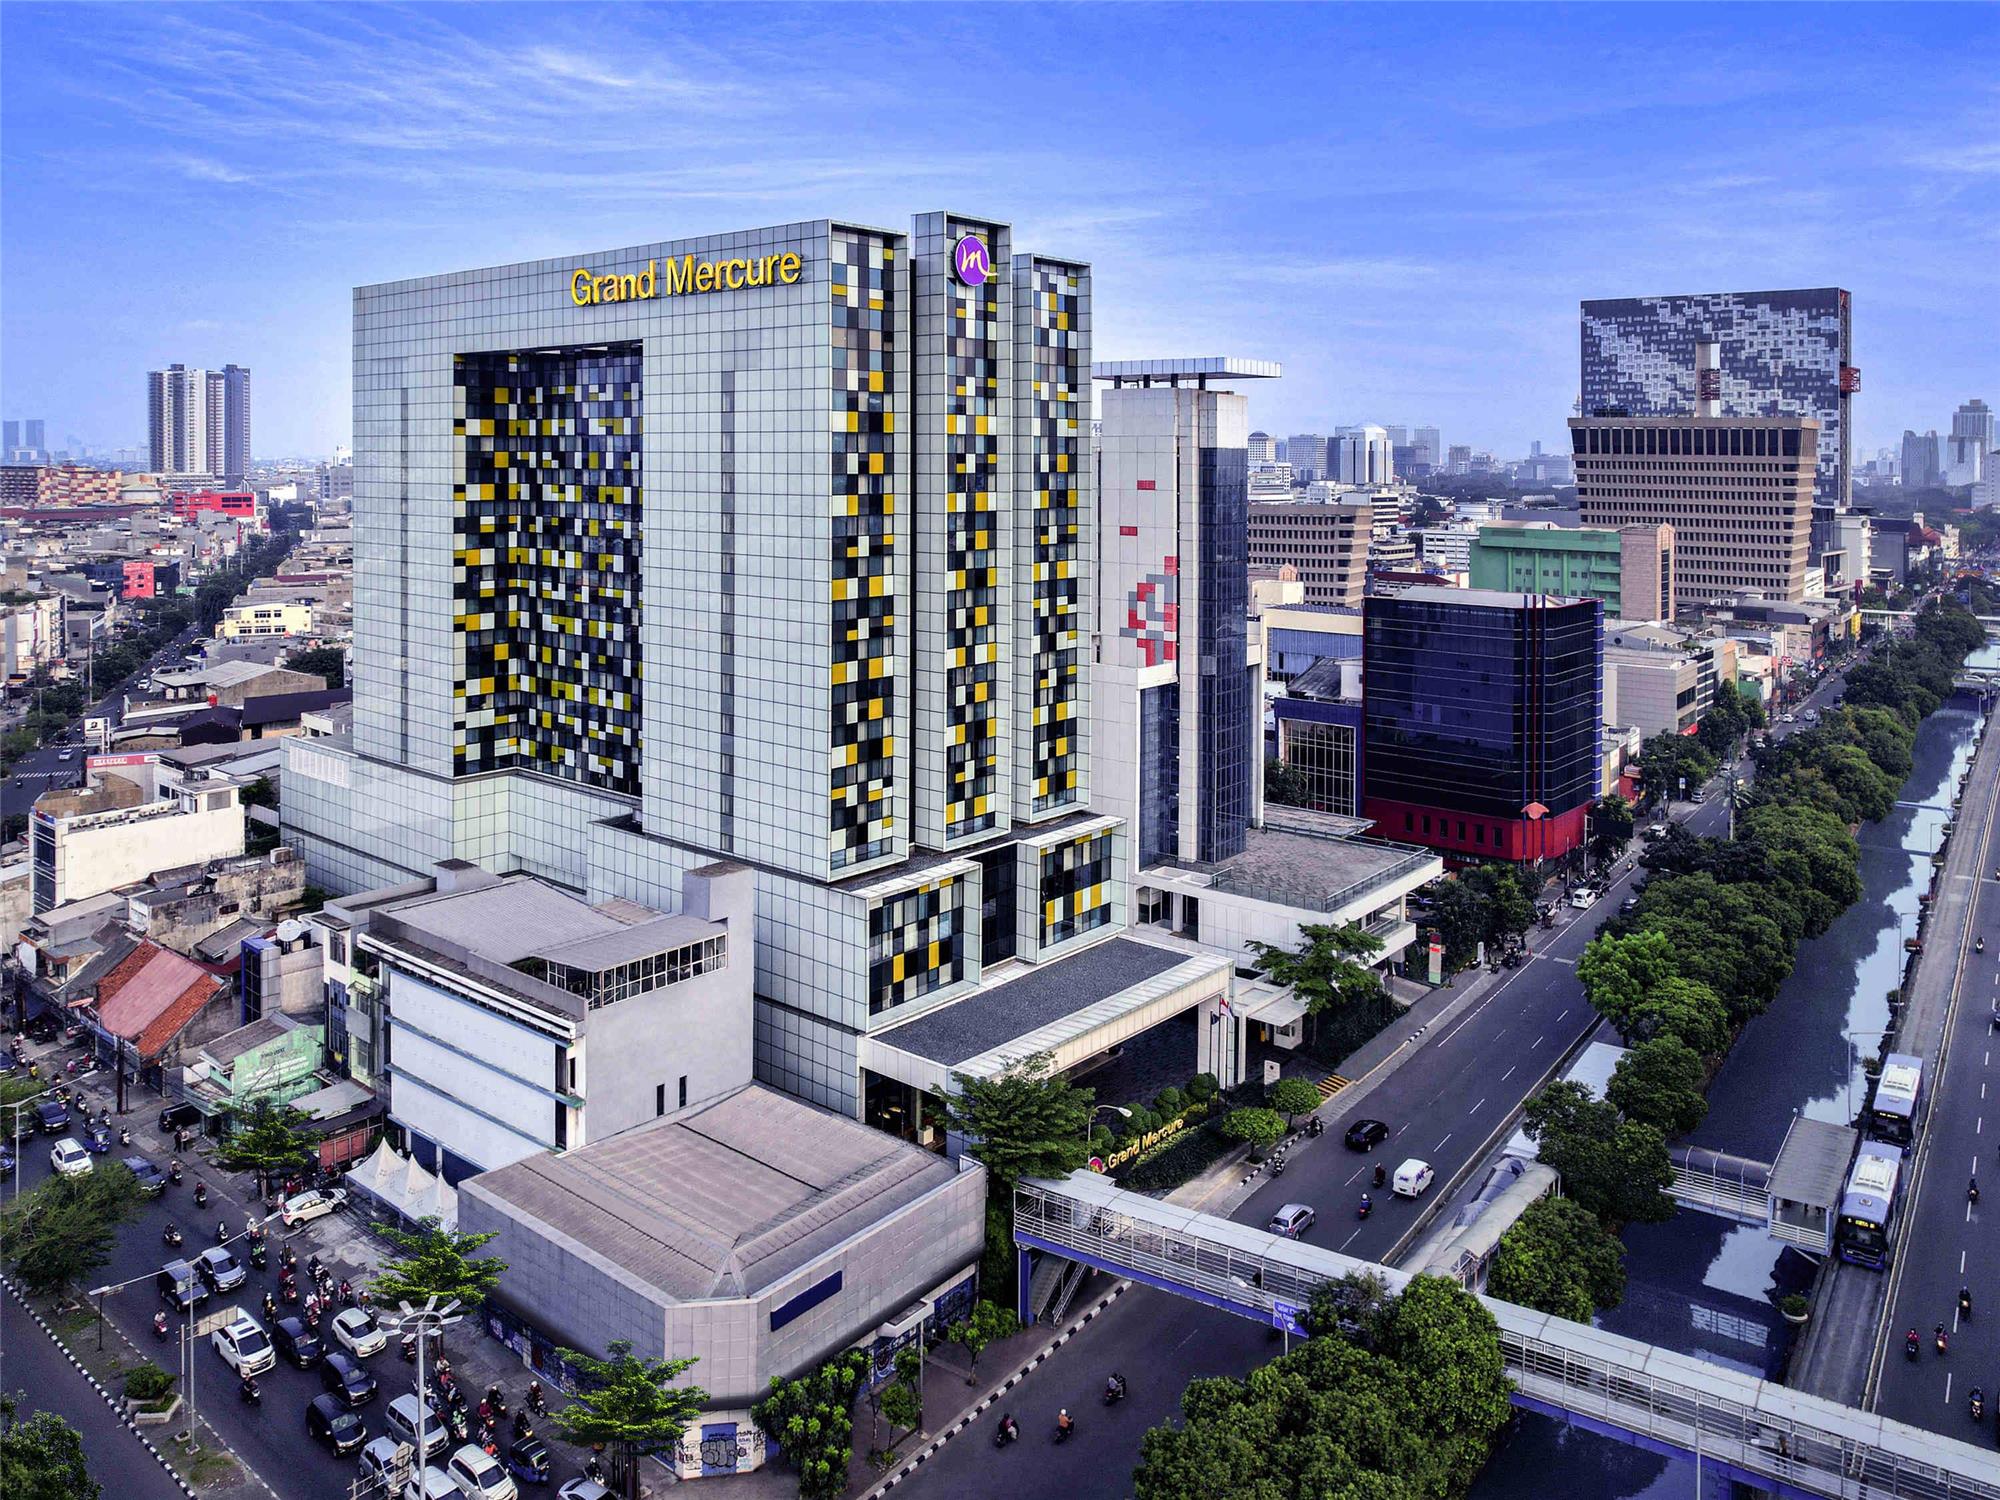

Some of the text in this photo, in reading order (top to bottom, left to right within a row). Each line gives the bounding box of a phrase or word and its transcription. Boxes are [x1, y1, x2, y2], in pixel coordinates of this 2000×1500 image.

[571, 251, 801, 306] Grand Mercure
[1108, 1119, 1184, 1168] Grand Mercure
